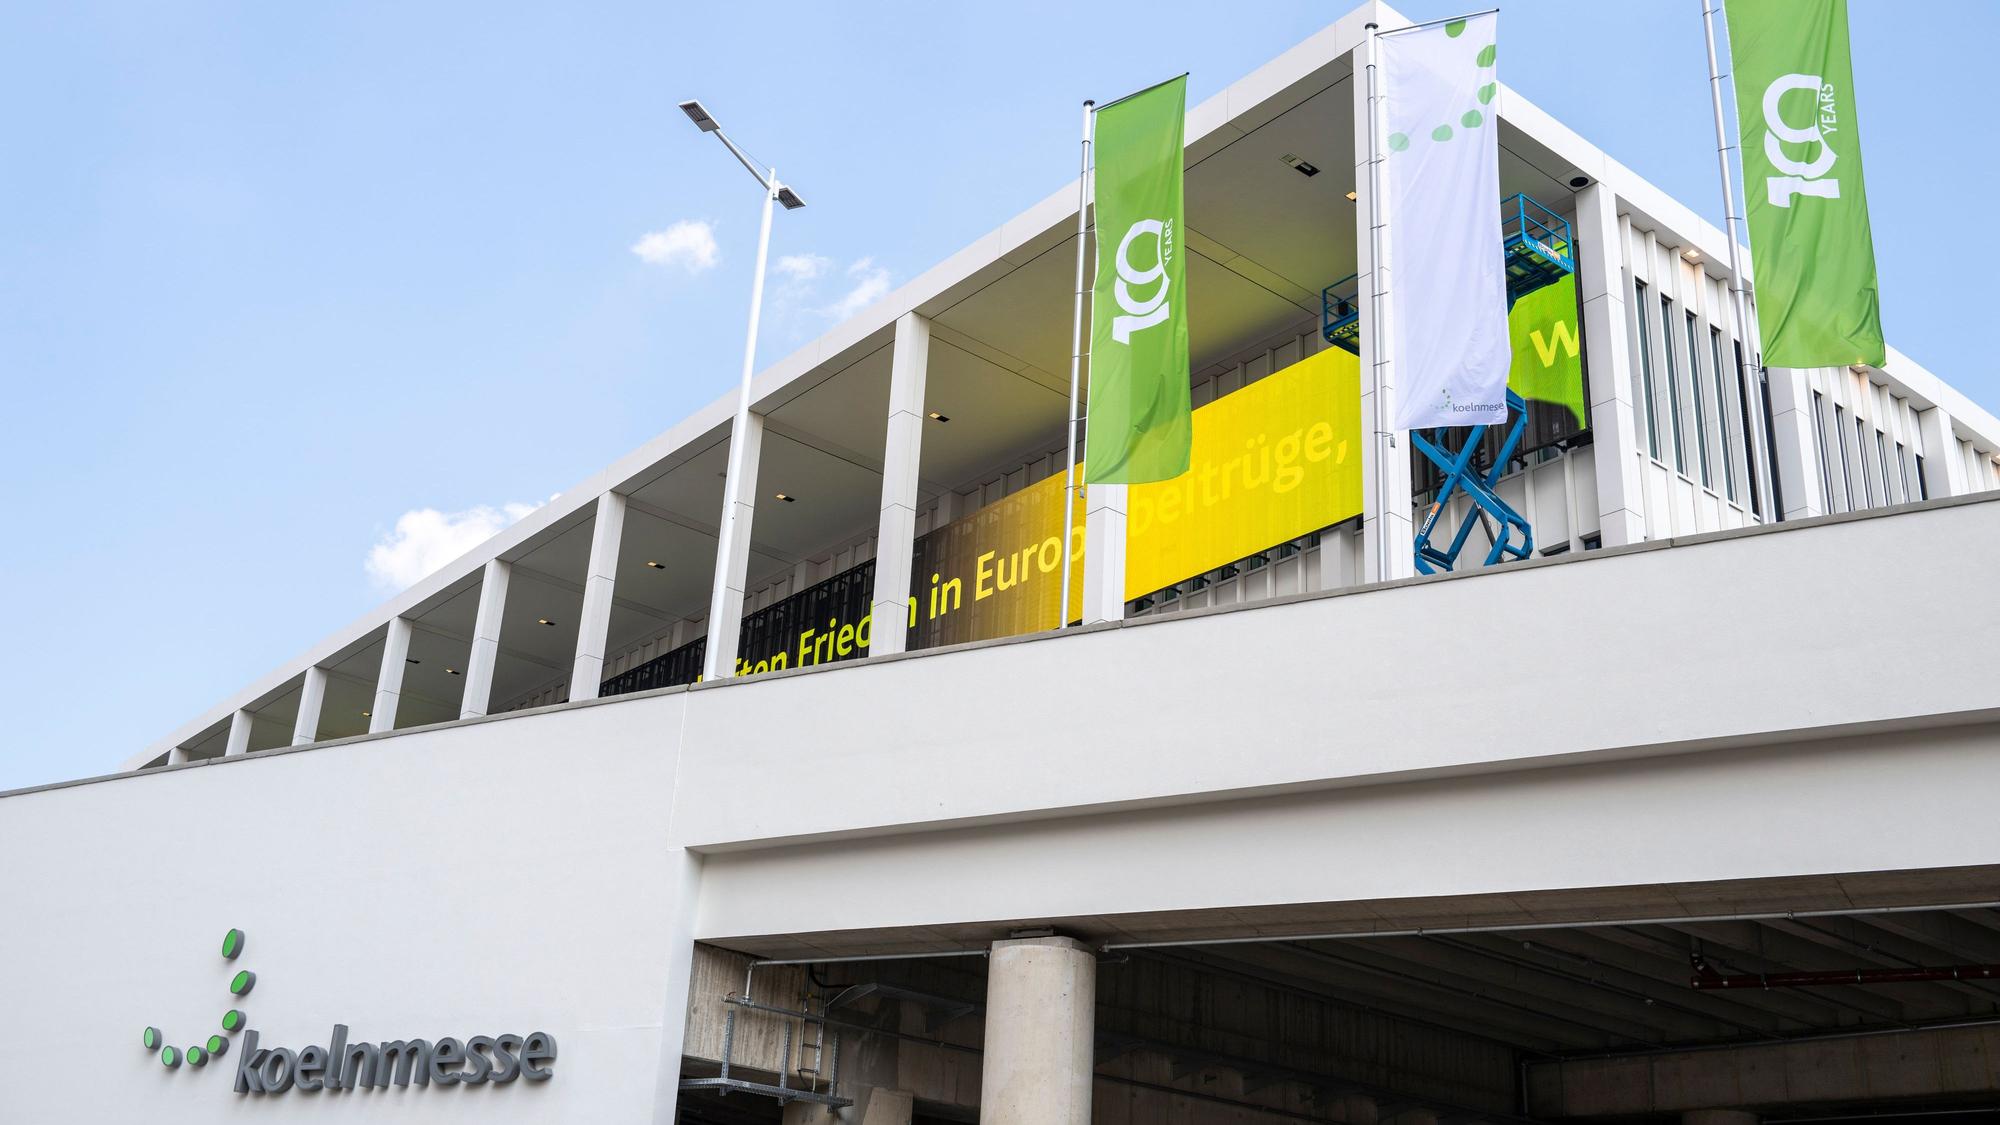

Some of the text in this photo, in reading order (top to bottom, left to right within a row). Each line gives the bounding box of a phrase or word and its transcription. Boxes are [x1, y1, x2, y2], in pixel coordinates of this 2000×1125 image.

[1820, 83, 1838, 135] YEARS
[1164, 217, 1174, 266] YEARS
[1452, 402, 1504, 413] koelnmese
[797, 596, 917, 668] Friedn
[929, 573, 962, 620] in
[975, 525, 1086, 601] Europ
[234, 1024, 557, 1094] koelnmesse
